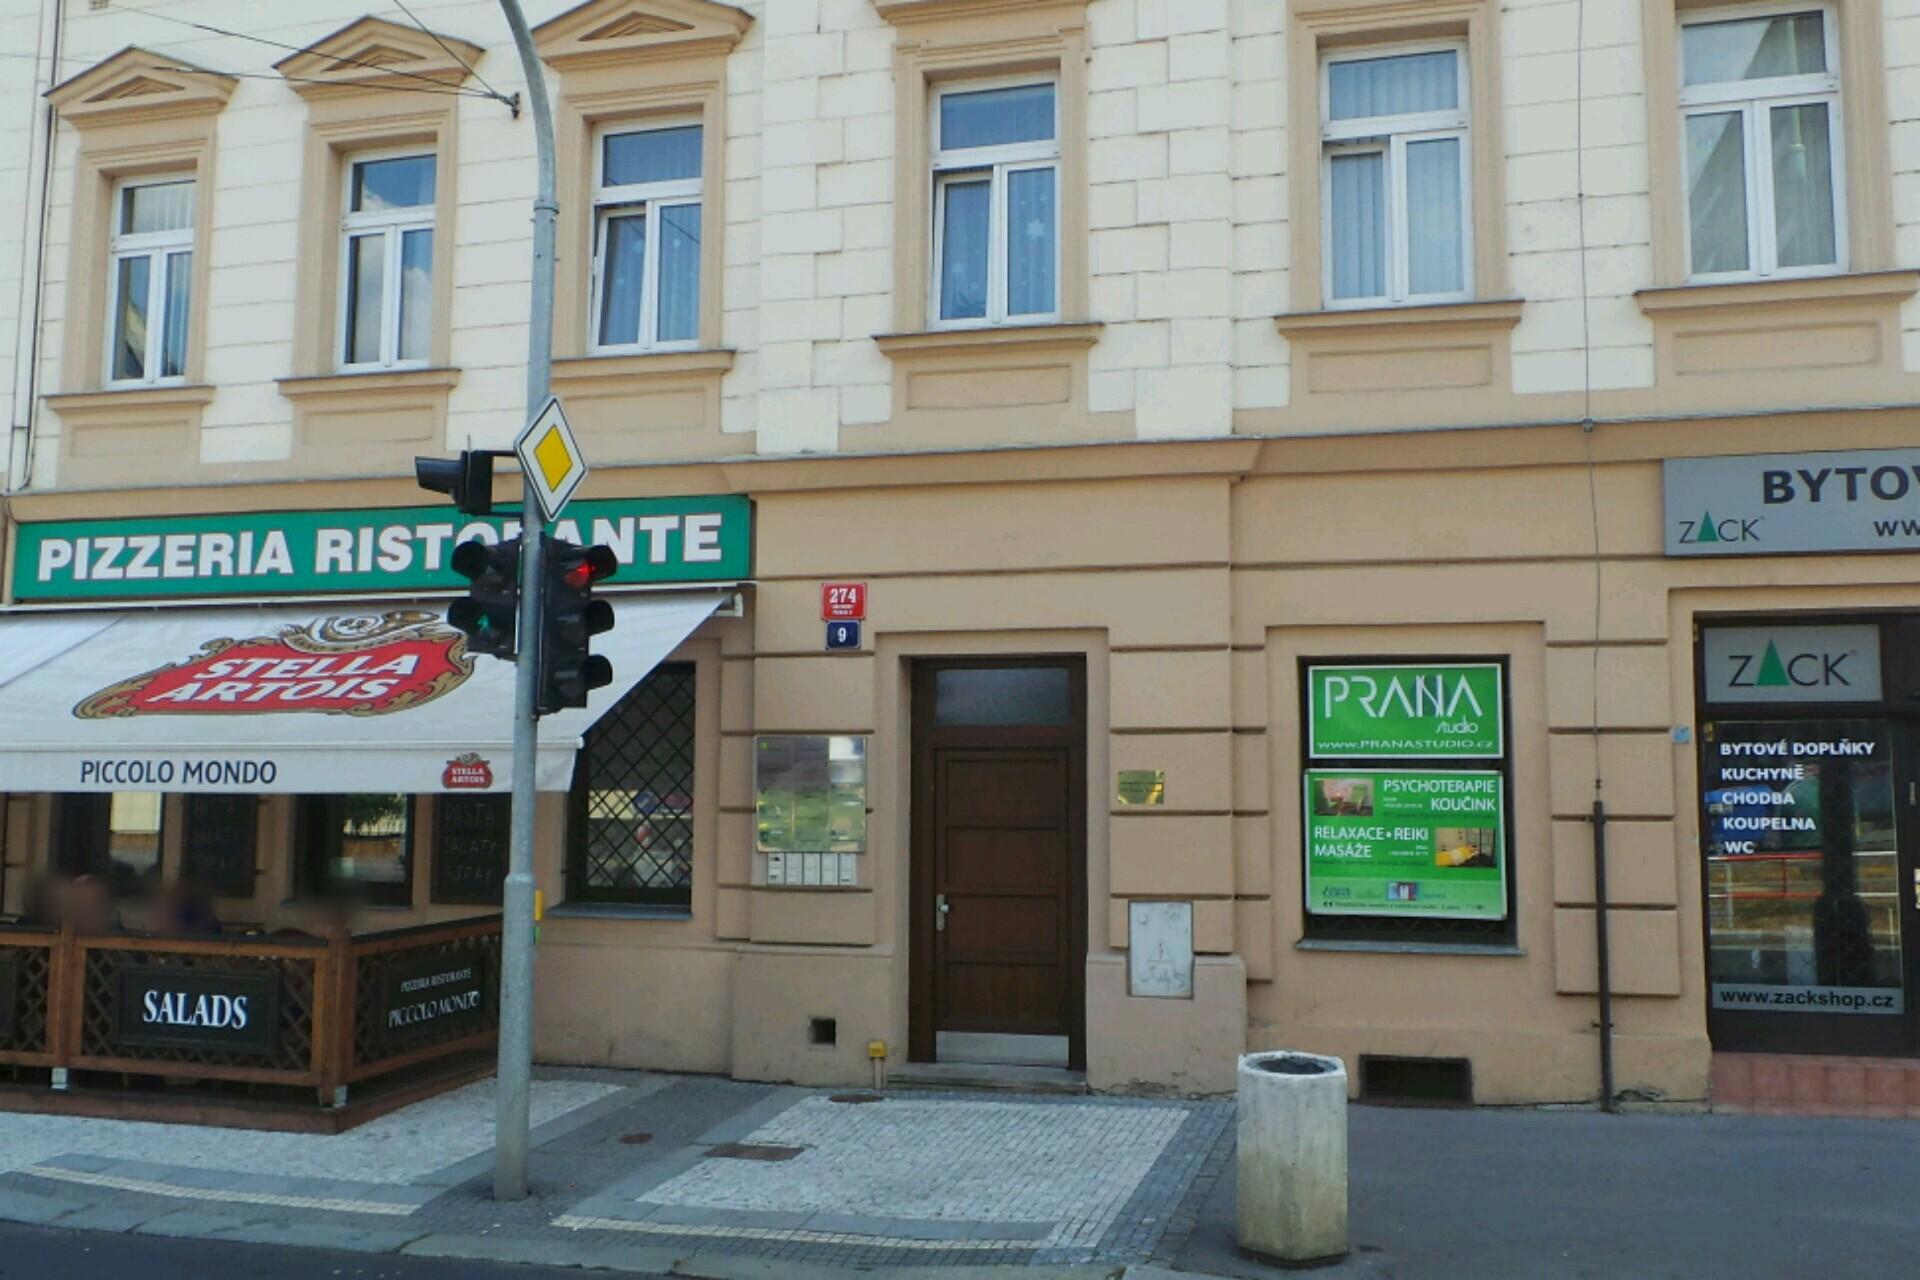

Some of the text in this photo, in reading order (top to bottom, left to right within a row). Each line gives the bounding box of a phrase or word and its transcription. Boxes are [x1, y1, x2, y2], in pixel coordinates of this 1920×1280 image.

[1763, 465, 1920, 505] BYTO
[37, 530, 294, 582] PIZZERIA
[829, 588, 856, 603] 274
[837, 627, 847, 643] 9
[193, 654, 420, 679] STELLA
[145, 678, 400, 702] ARTOIS
[1324, 674, 1483, 718] PRANA
[1720, 739, 1875, 755] BYTOVÉ DOPLŇKY
[80, 760, 276, 784] PICCOLO MONDO
[1722, 764, 1804, 780] KUCHYNĚ
[1383, 779, 1496, 793] PSYCHOTERAPIE
[1431, 796, 1496, 811] KOUČINK
[1722, 791, 1795, 804] CHODBA
[1723, 817, 1816, 830] KOUPELNA
[1314, 827, 1428, 841] RELAXACE REIKI
[1314, 843, 1372, 858] MASÁŽE
[1725, 841, 1755, 854] WC
[1720, 990, 1895, 1010] www.zackshop.cz
[143, 989, 248, 1029] SALADS
[388, 990, 481, 1028] PICCOLO MONDO
